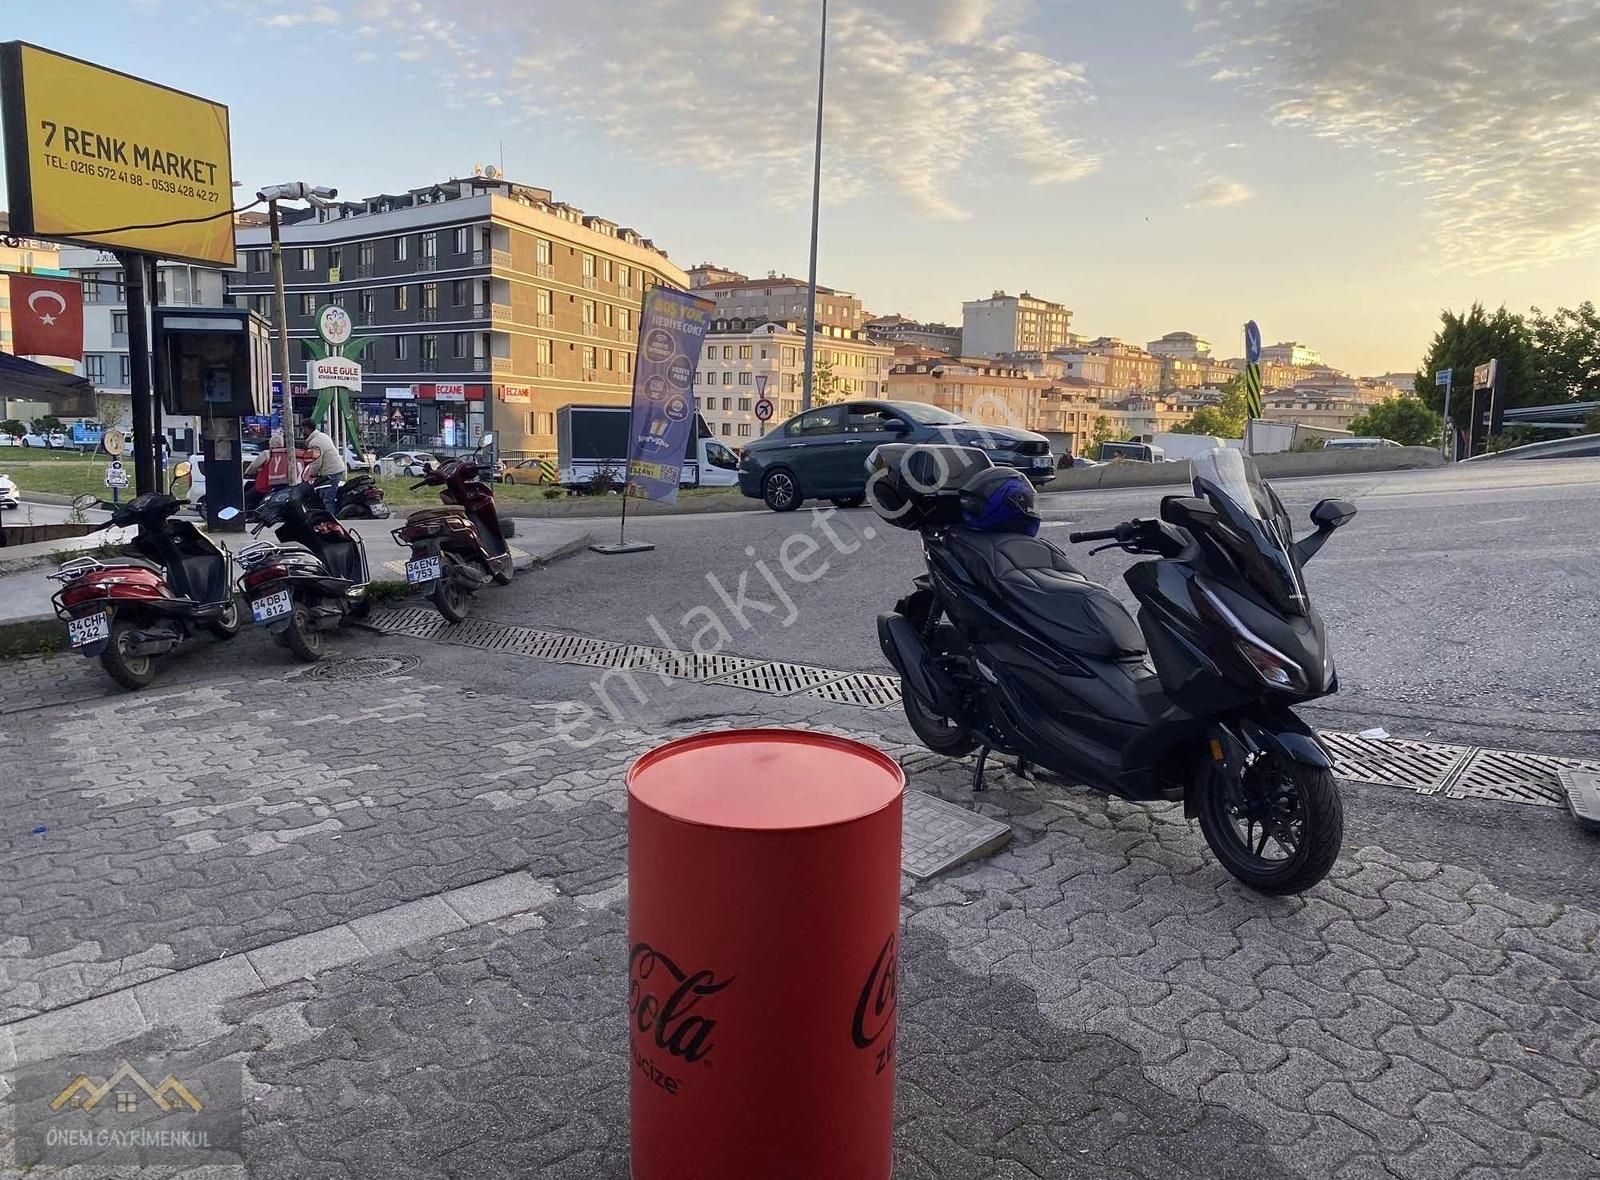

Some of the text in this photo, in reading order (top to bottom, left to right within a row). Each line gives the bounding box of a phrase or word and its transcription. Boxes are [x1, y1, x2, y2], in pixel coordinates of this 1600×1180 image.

[41, 121, 217, 186] 7 RENK MARKET
[44, 153, 68, 170] TEL:
[71, 160, 95, 176] 0216
[97, 166, 116, 181] 572
[118, 171, 128, 184] 41
[130, 174, 143, 187] 98
[152, 179, 176, 194] 0539
[177, 185, 195, 198] 428
[196, 189, 207, 201] 42
[208, 192, 220, 203] 27
[436, 385, 463, 395] ECZANE
[506, 386, 529, 397] ECZANE
[408, 557, 439, 572] 34 ENZ
[416, 567, 433, 580] 753
[253, 592, 288, 611] 34 DBJ
[266, 604, 285, 617] 812
[70, 612, 106, 633] 34 CHH
[79, 626, 100, 641] 242
